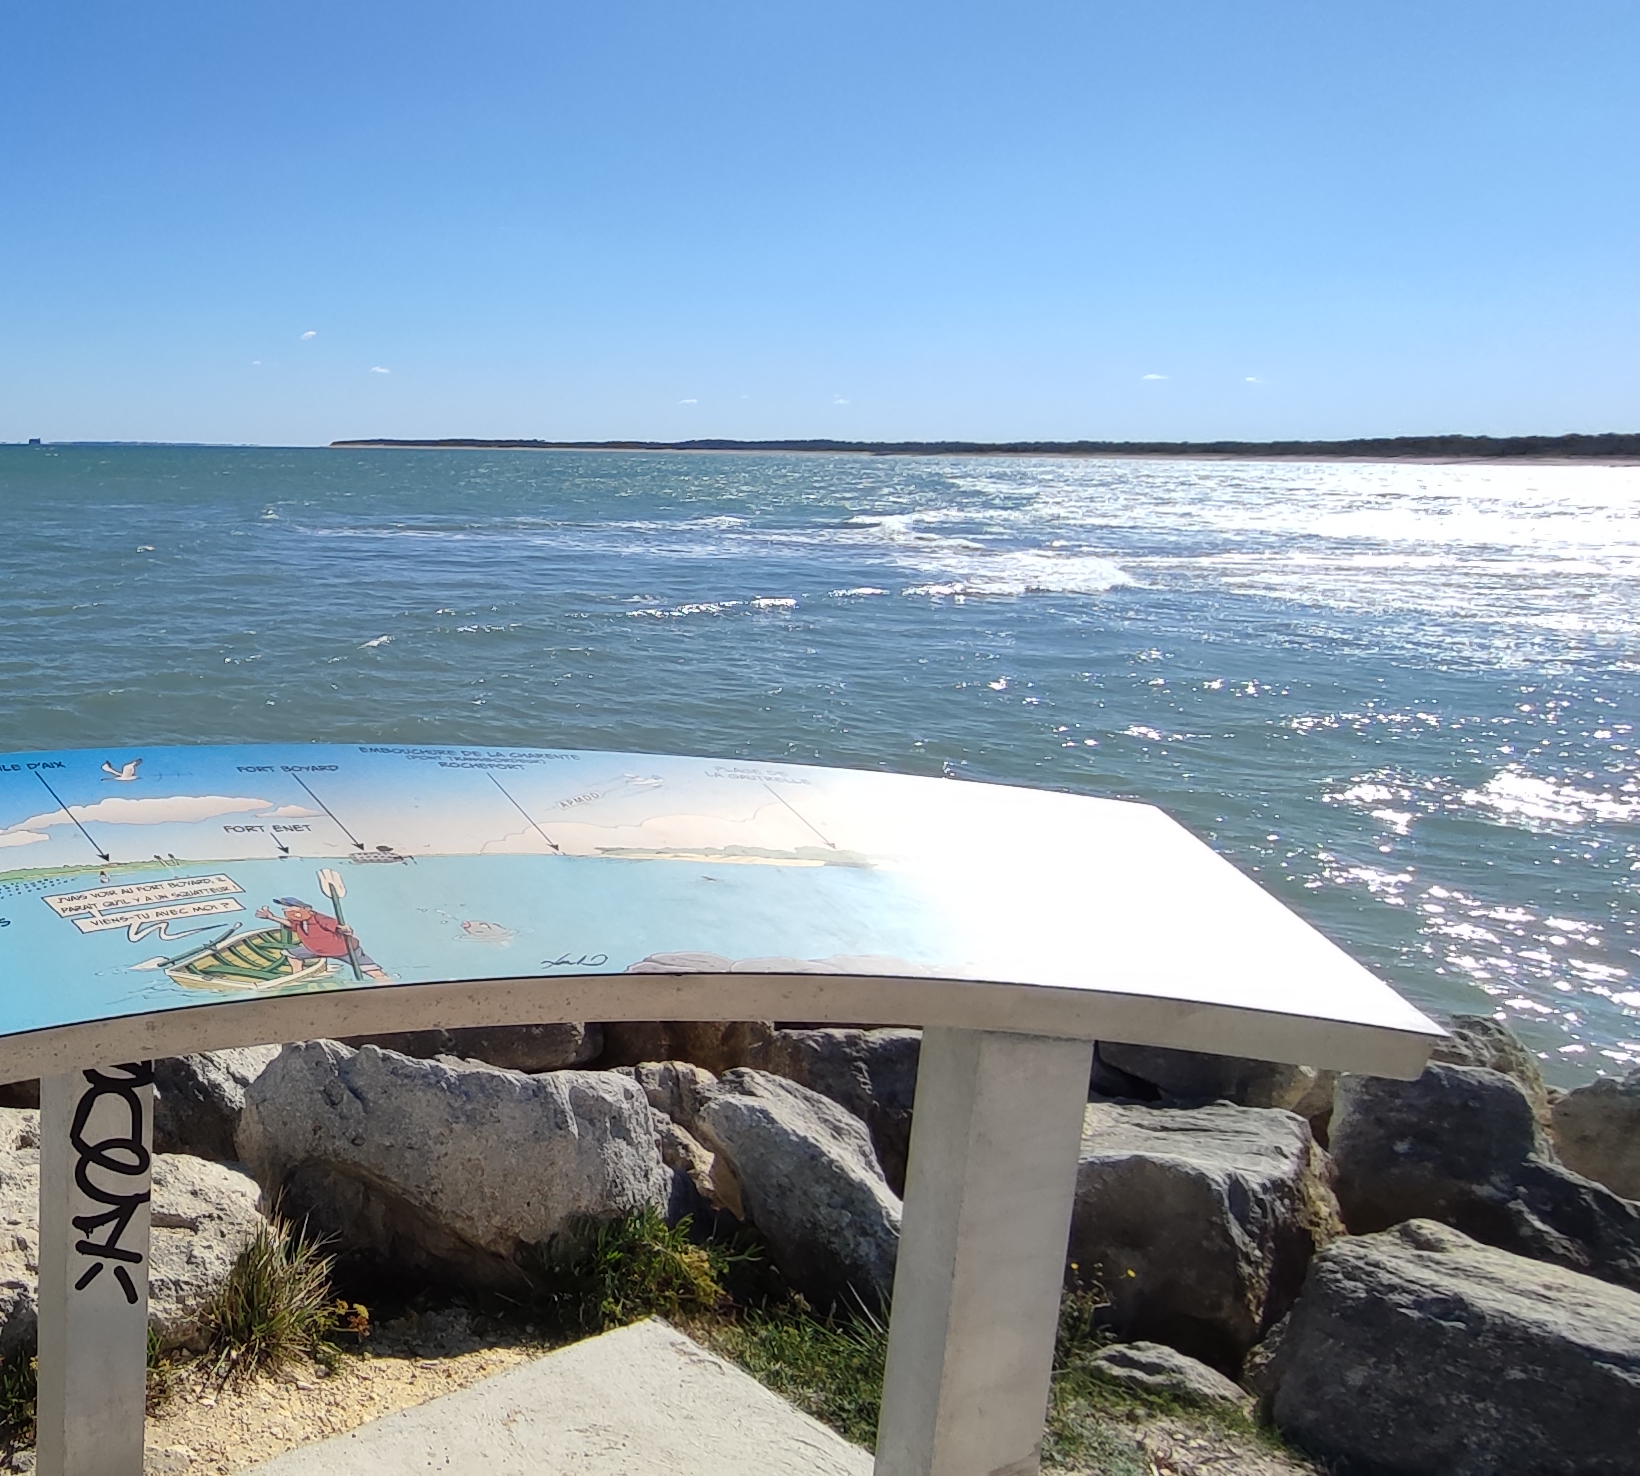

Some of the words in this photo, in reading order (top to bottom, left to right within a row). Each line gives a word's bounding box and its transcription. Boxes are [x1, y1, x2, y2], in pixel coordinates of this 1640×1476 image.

[359, 747, 457, 757] EMBOUCHURE
[509, 752, 581, 761] CHARENTE
[26, 760, 67, 771] D'AIX
[236, 764, 276, 774] FORT
[280, 764, 339, 773] BOYARD
[438, 761, 525, 771] ROCHEFORT
[704, 770, 723, 778] LA
[223, 824, 266, 834] FORT
[272, 823, 312, 833] ENET
[90, 889, 118, 899] VOIR
[121, 887, 134, 895] AU
[136, 883, 164, 893] FORT
[154, 893, 170, 901] UN
[171, 886, 230, 899] SQUATTEUR
[90, 911, 150, 927] VIENS-TU
[155, 906, 189, 918] AVEC
[192, 904, 217, 913] MOI
[221, 902, 230, 910] ?
